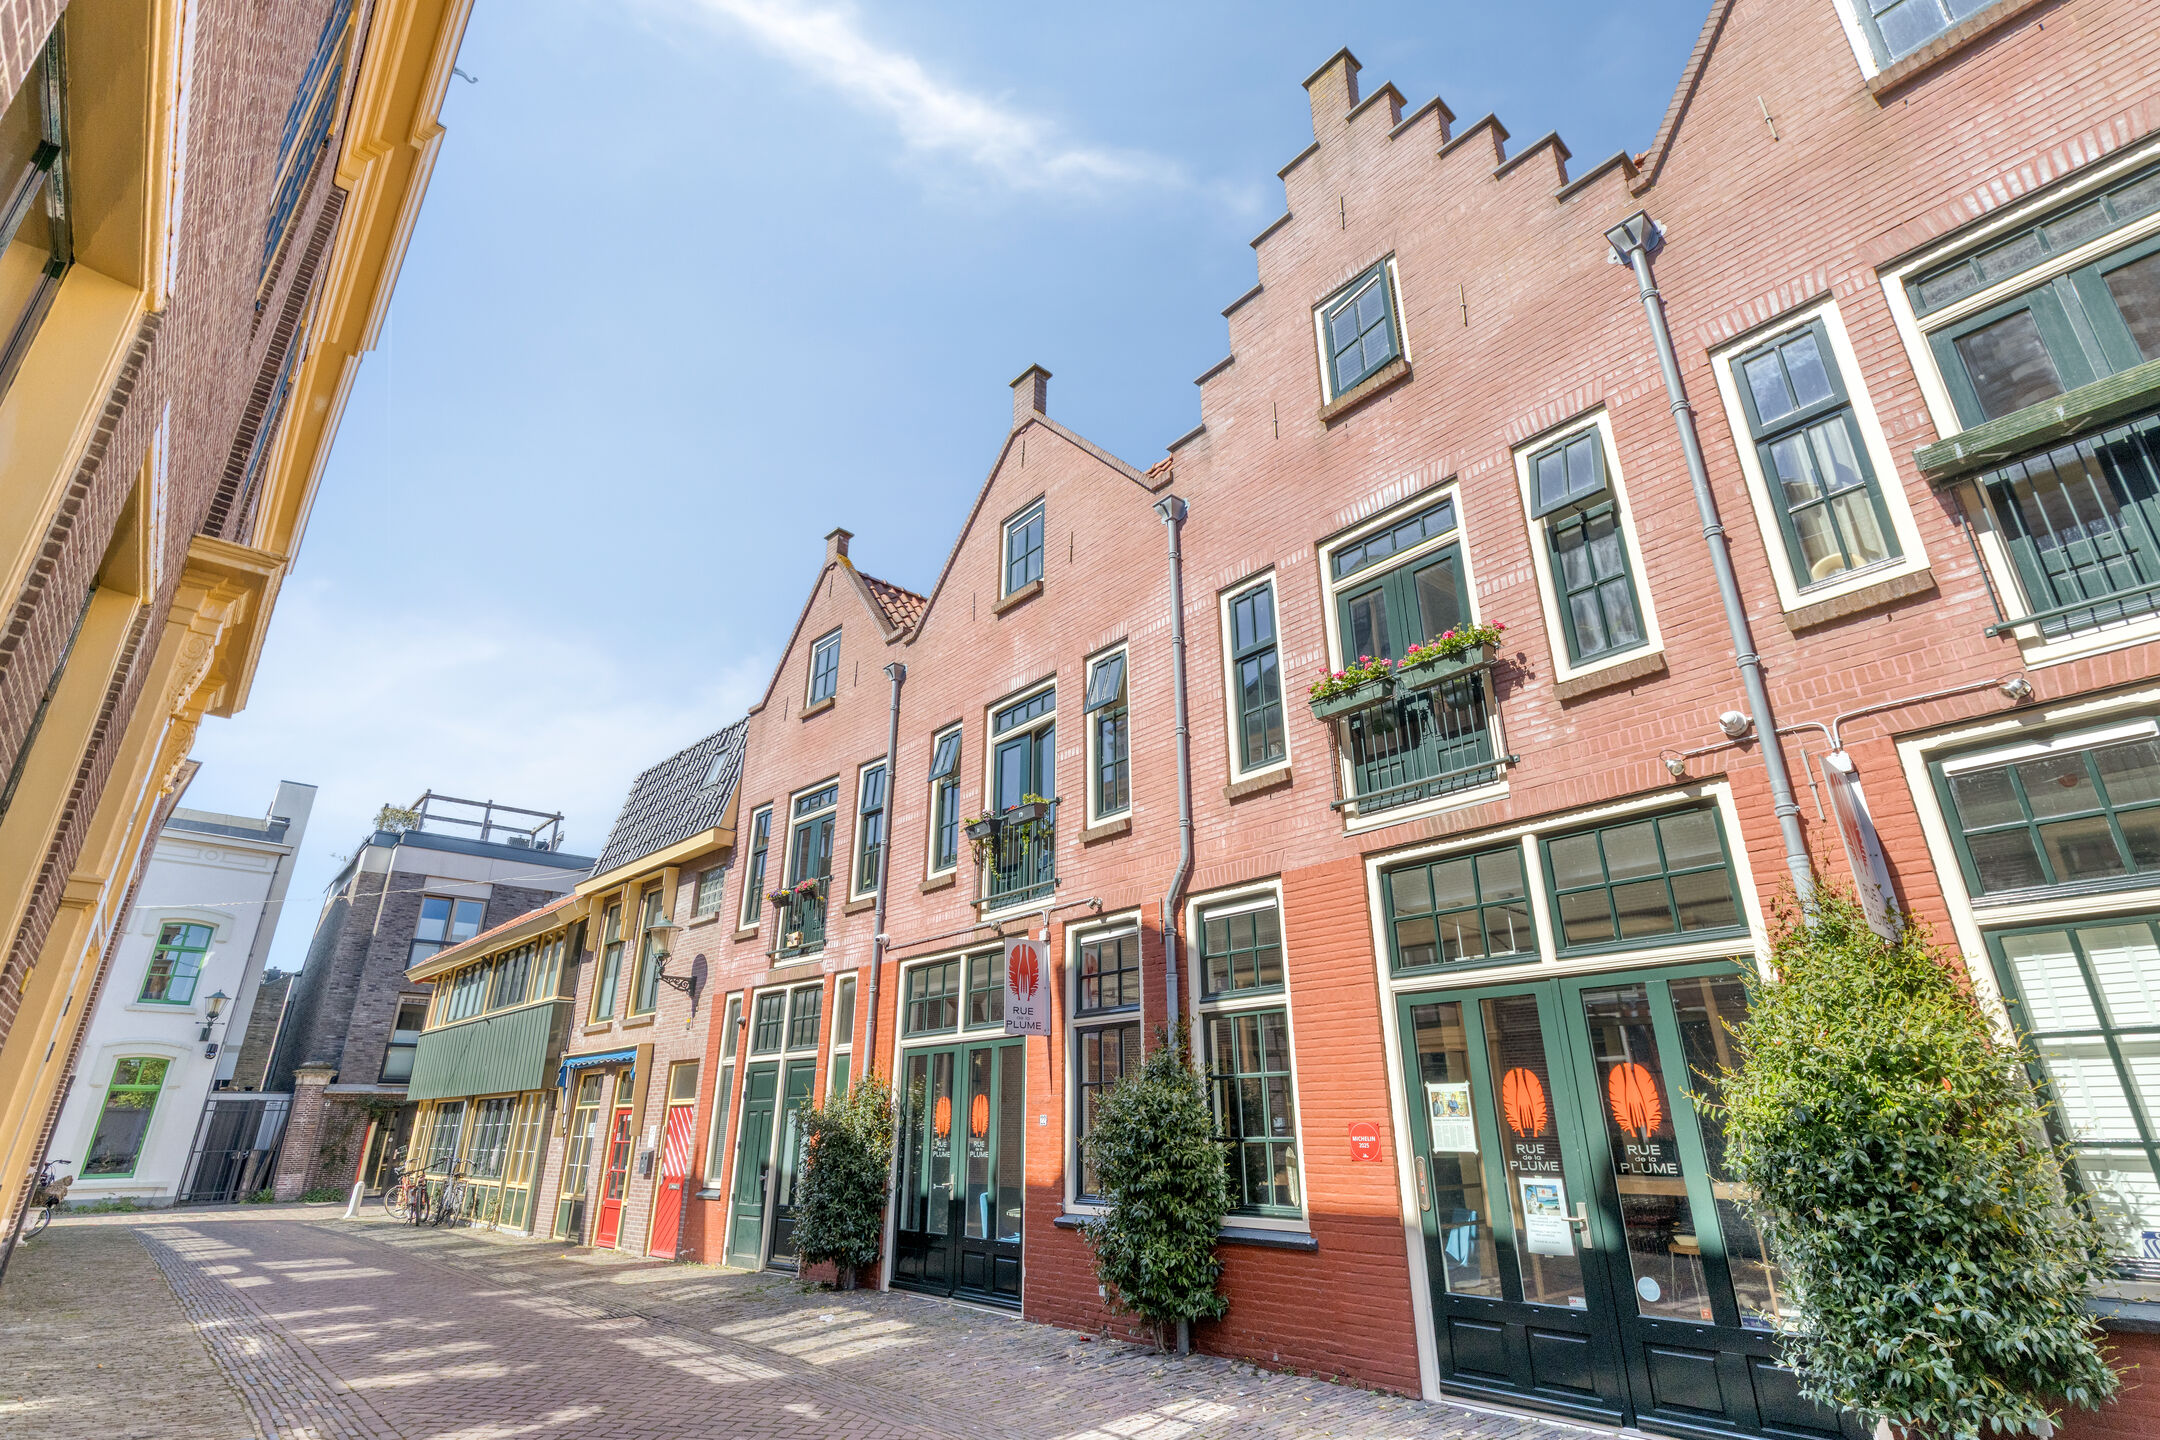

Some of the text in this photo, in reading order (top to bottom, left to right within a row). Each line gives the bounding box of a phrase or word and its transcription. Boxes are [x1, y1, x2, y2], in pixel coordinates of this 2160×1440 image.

[1012, 1006, 1034, 1016] RUE
[1006, 1020, 1042, 1030] PLUME
[1515, 1144, 1546, 1154] RUE
[1626, 1144, 1661, 1155] RUE
[1509, 1160, 1560, 1172] PLUME
[1620, 1162, 1679, 1174] PLUME
